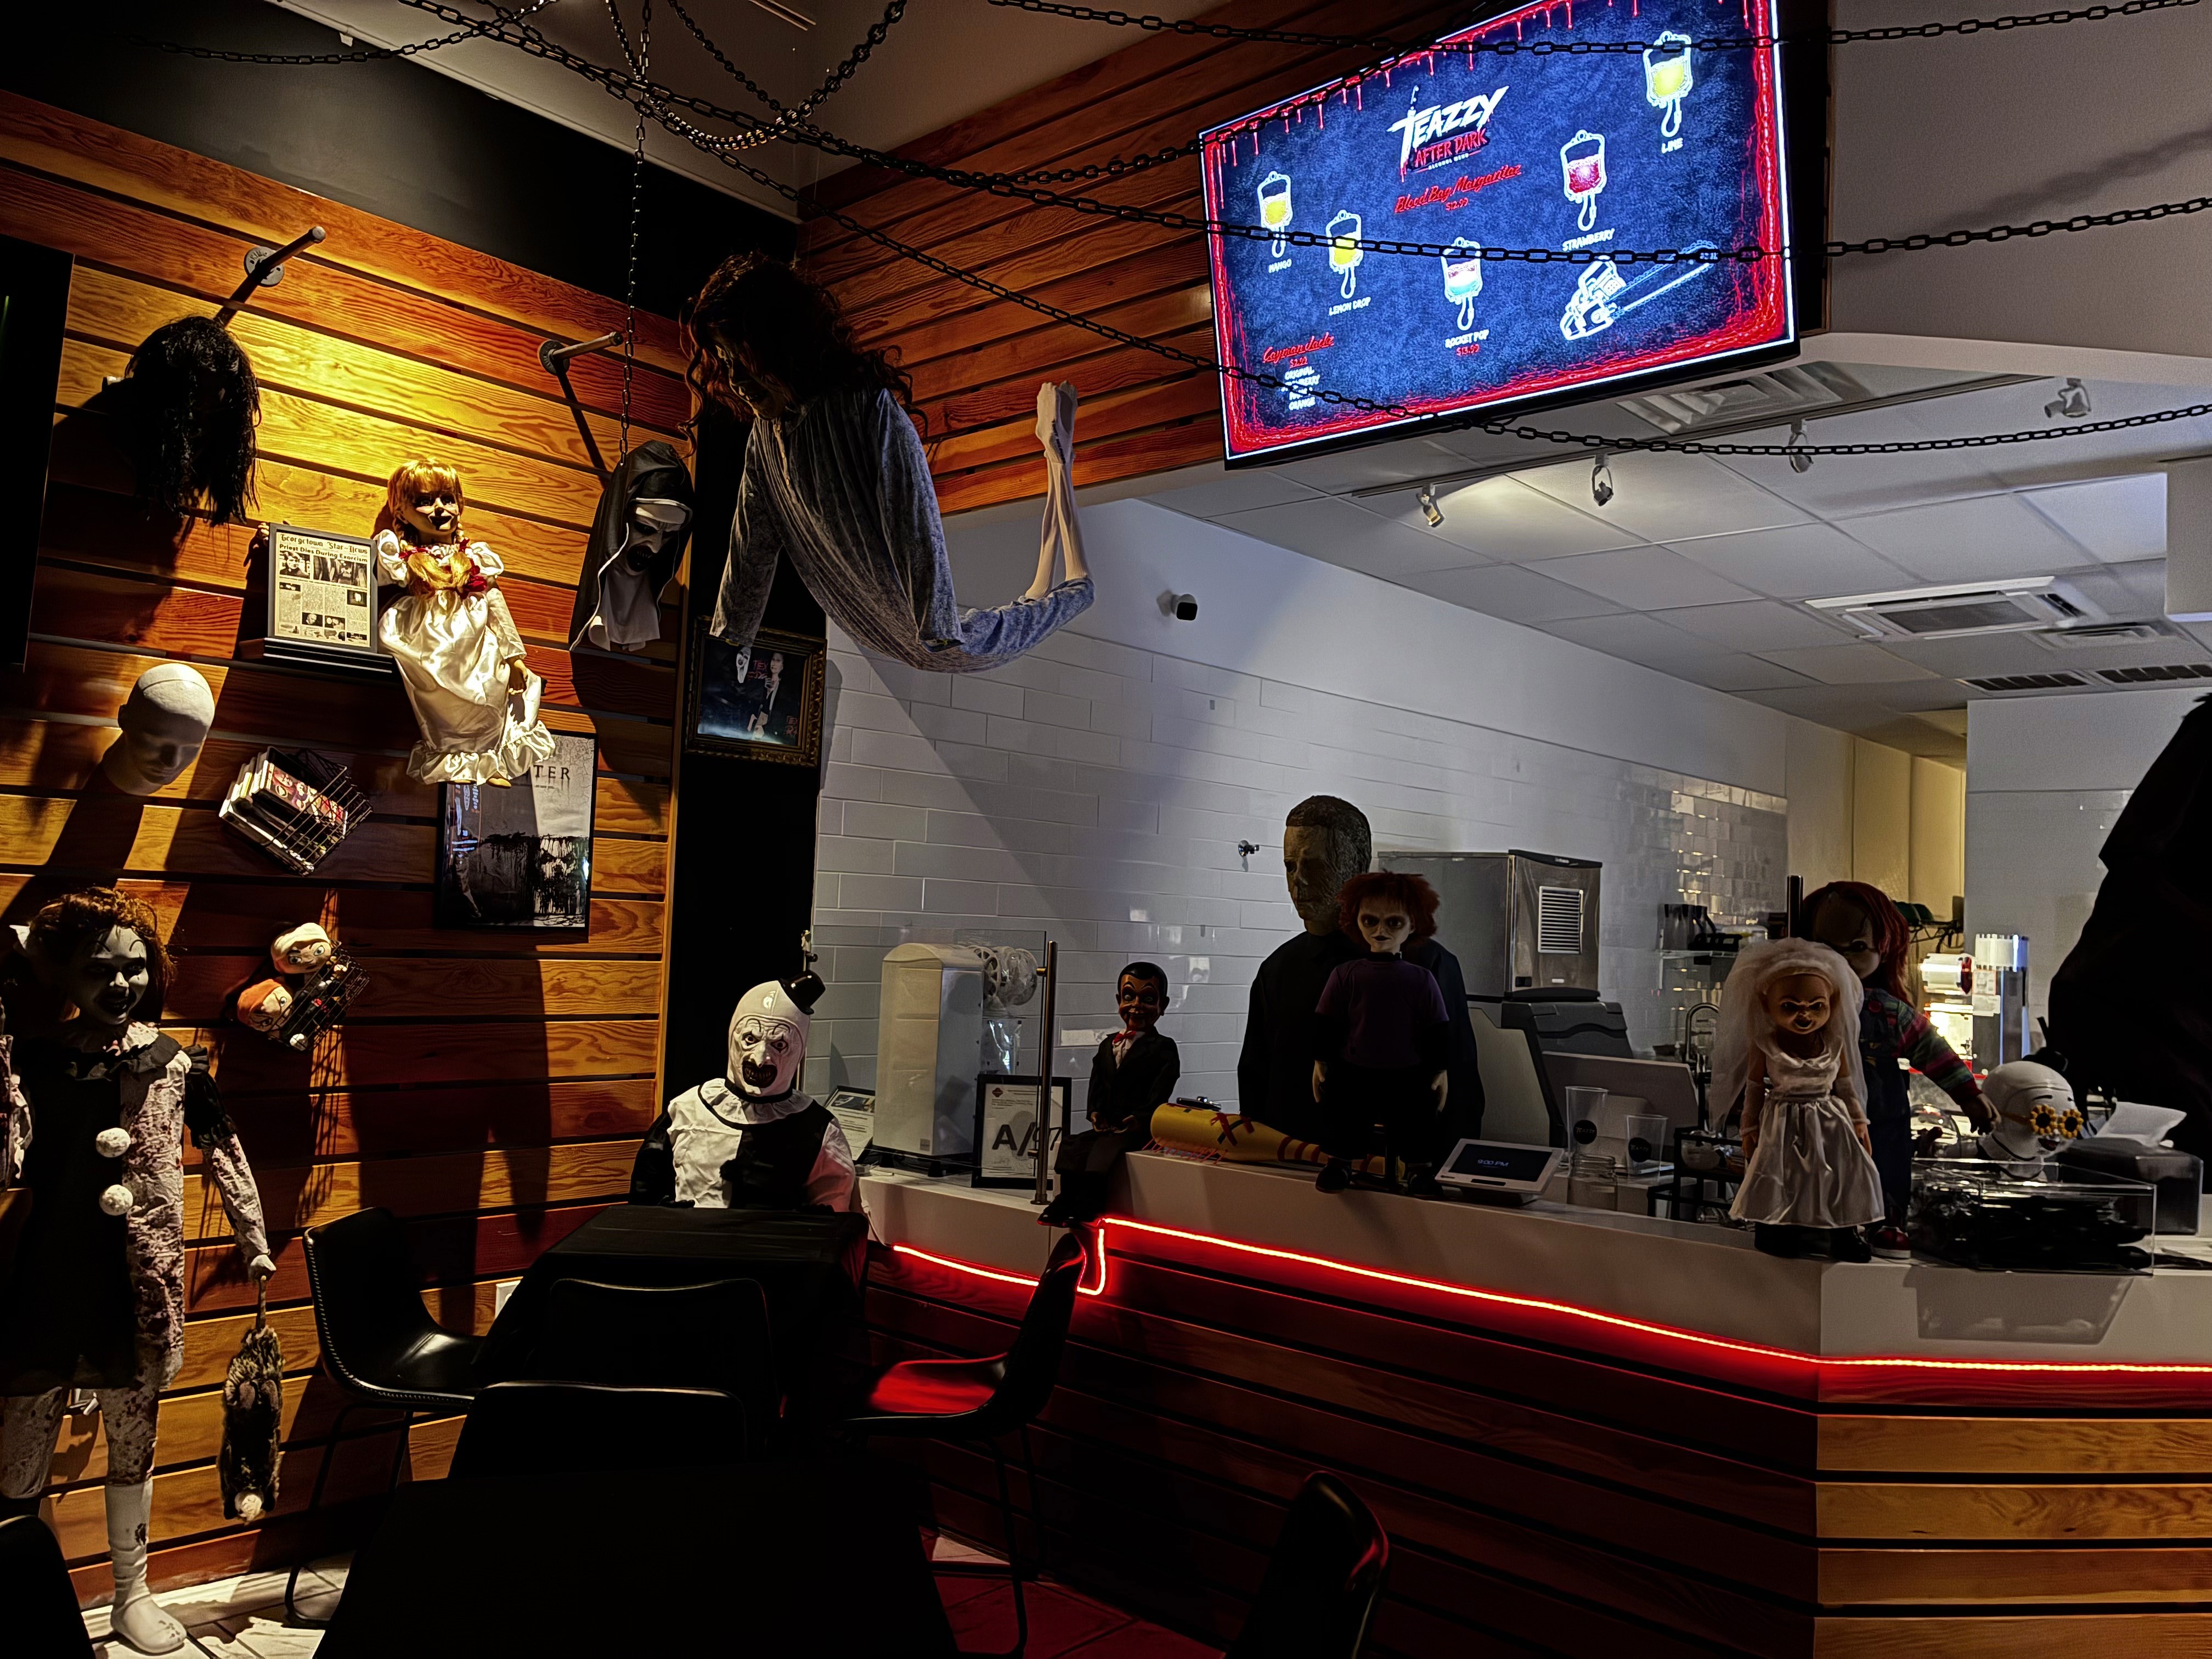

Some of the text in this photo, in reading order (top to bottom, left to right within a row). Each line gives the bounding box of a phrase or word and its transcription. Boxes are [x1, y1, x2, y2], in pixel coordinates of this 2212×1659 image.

[1387, 86, 1509, 171] TEAZZY
[1414, 128, 1487, 167] AFTER DARK
[1661, 138, 1683, 154] LIME
[1395, 188, 1429, 213] Blood
[1428, 185, 1453, 203] Bag
[1445, 198, 1468, 211] $12.99
[1562, 228, 1615, 251] STRAWBERRY
[1268, 258, 1292, 273] MANGO
[1328, 296, 1371, 316] LEMON DROP
[1445, 329, 1489, 348] ROCKET POP
[1262, 345, 1305, 364] Cayman
[1284, 366, 1315, 380] ORIGINAL
[1289, 397, 1316, 411] ORANGE
[280, 534, 324, 547] Georgetown
[315, 550, 338, 560] During
[340, 554, 368, 562] Exorcism
[533, 764, 571, 780] TER
